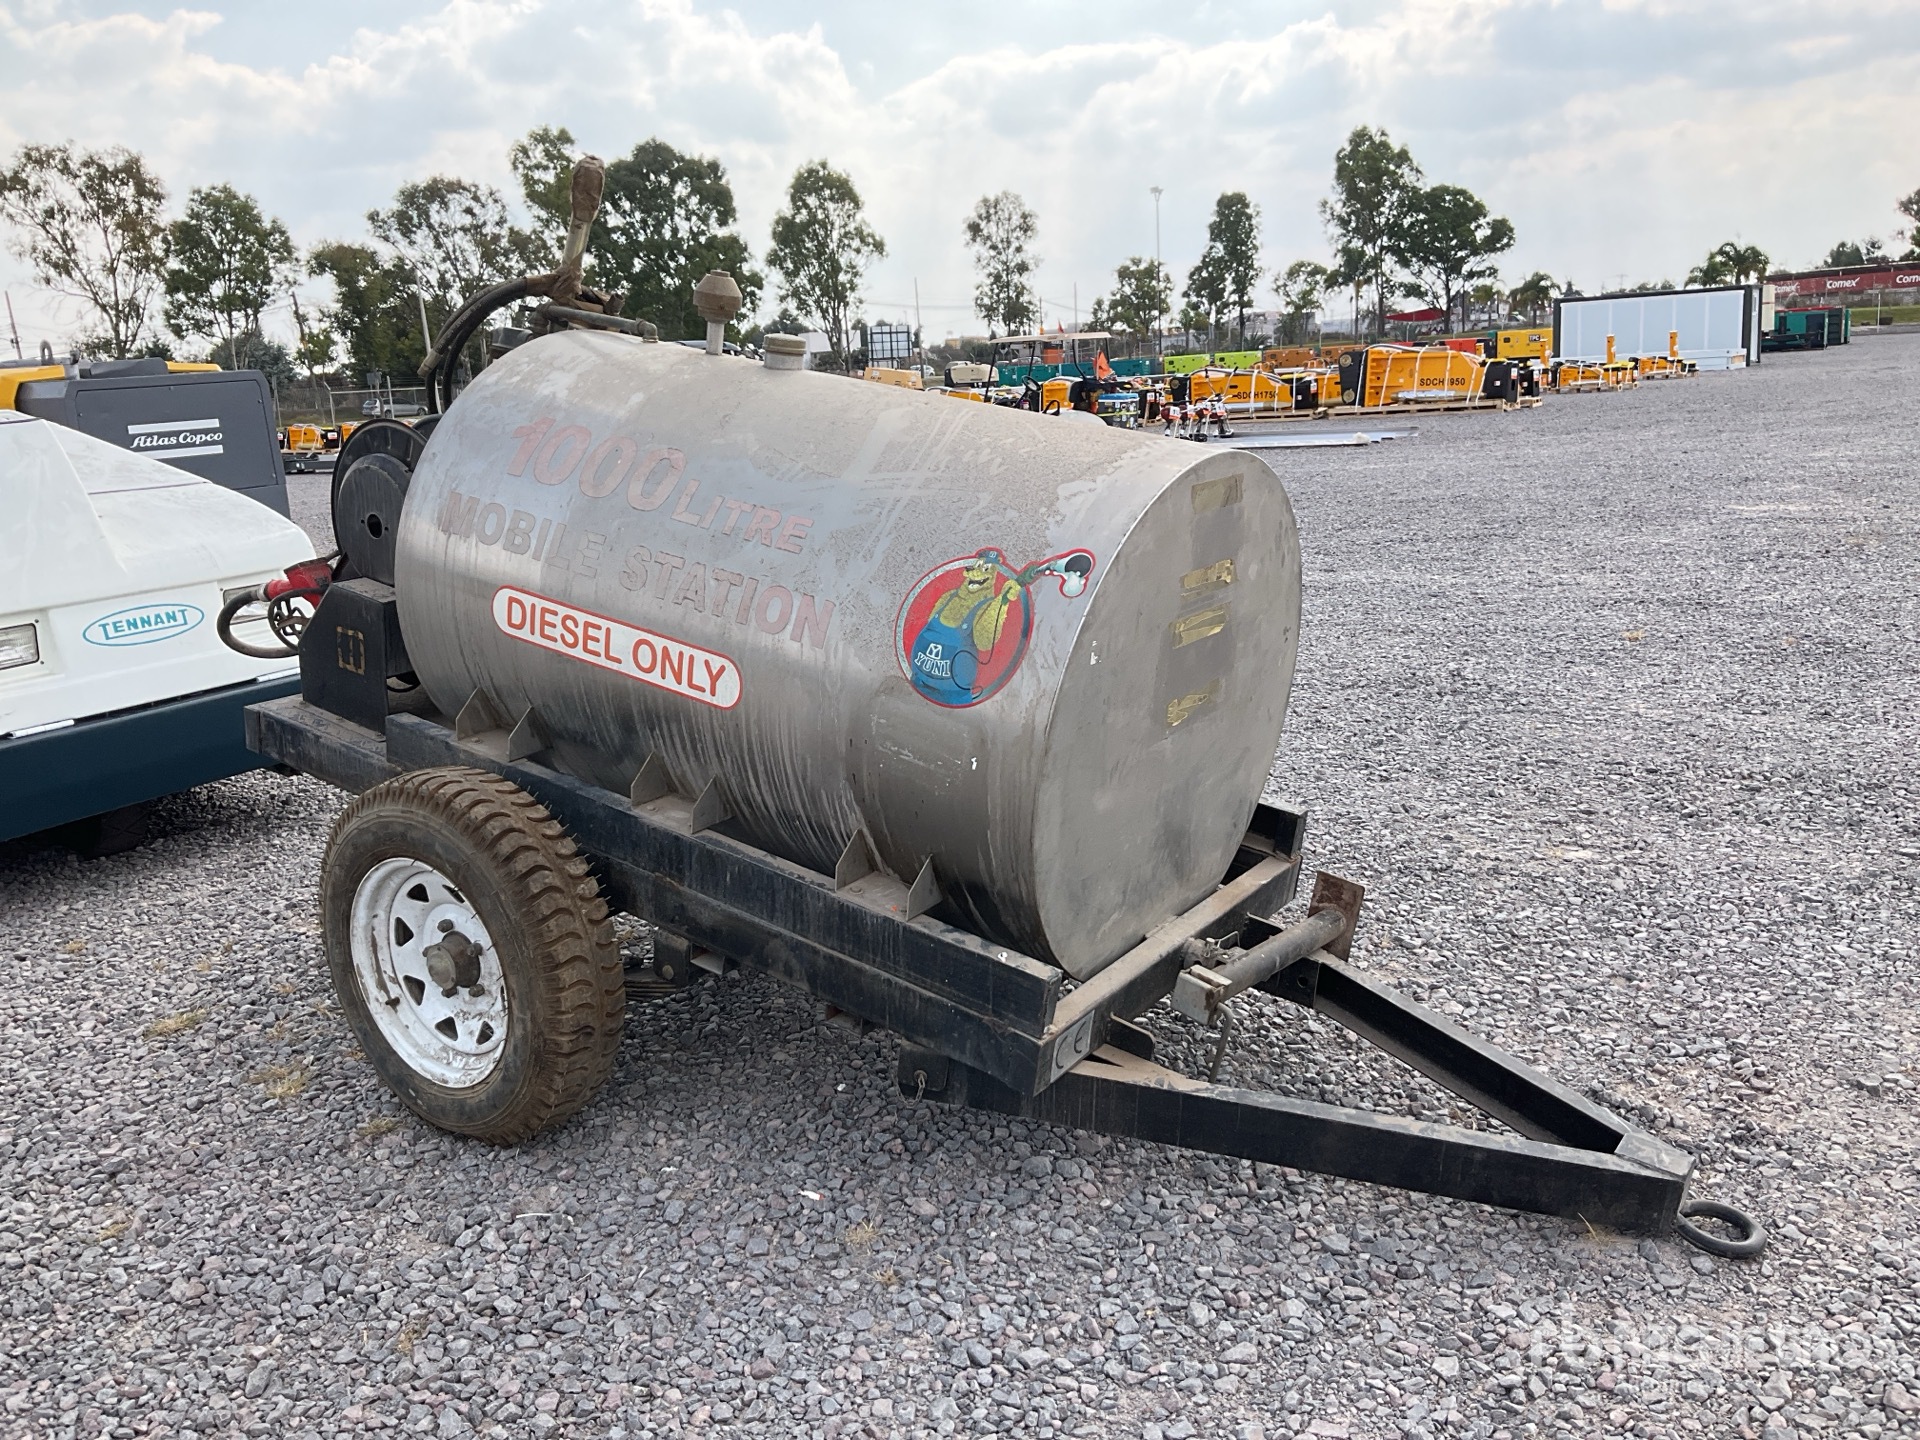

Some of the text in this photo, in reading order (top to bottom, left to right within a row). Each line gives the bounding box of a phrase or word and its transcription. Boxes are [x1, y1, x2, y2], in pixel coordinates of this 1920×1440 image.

[1827, 276, 1860, 289] Comex
[1896, 274, 1920, 284] Com
[1419, 377, 1466, 387] SDCH950
[129, 432, 223, 449] Atlas Copco
[506, 416, 814, 555] 1000 LITRE
[438, 490, 837, 650] MOBILE STATION
[98, 608, 188, 640] TENNANT
[505, 595, 727, 698] DIESEL ONLY
[913, 651, 951, 677] YUNI
